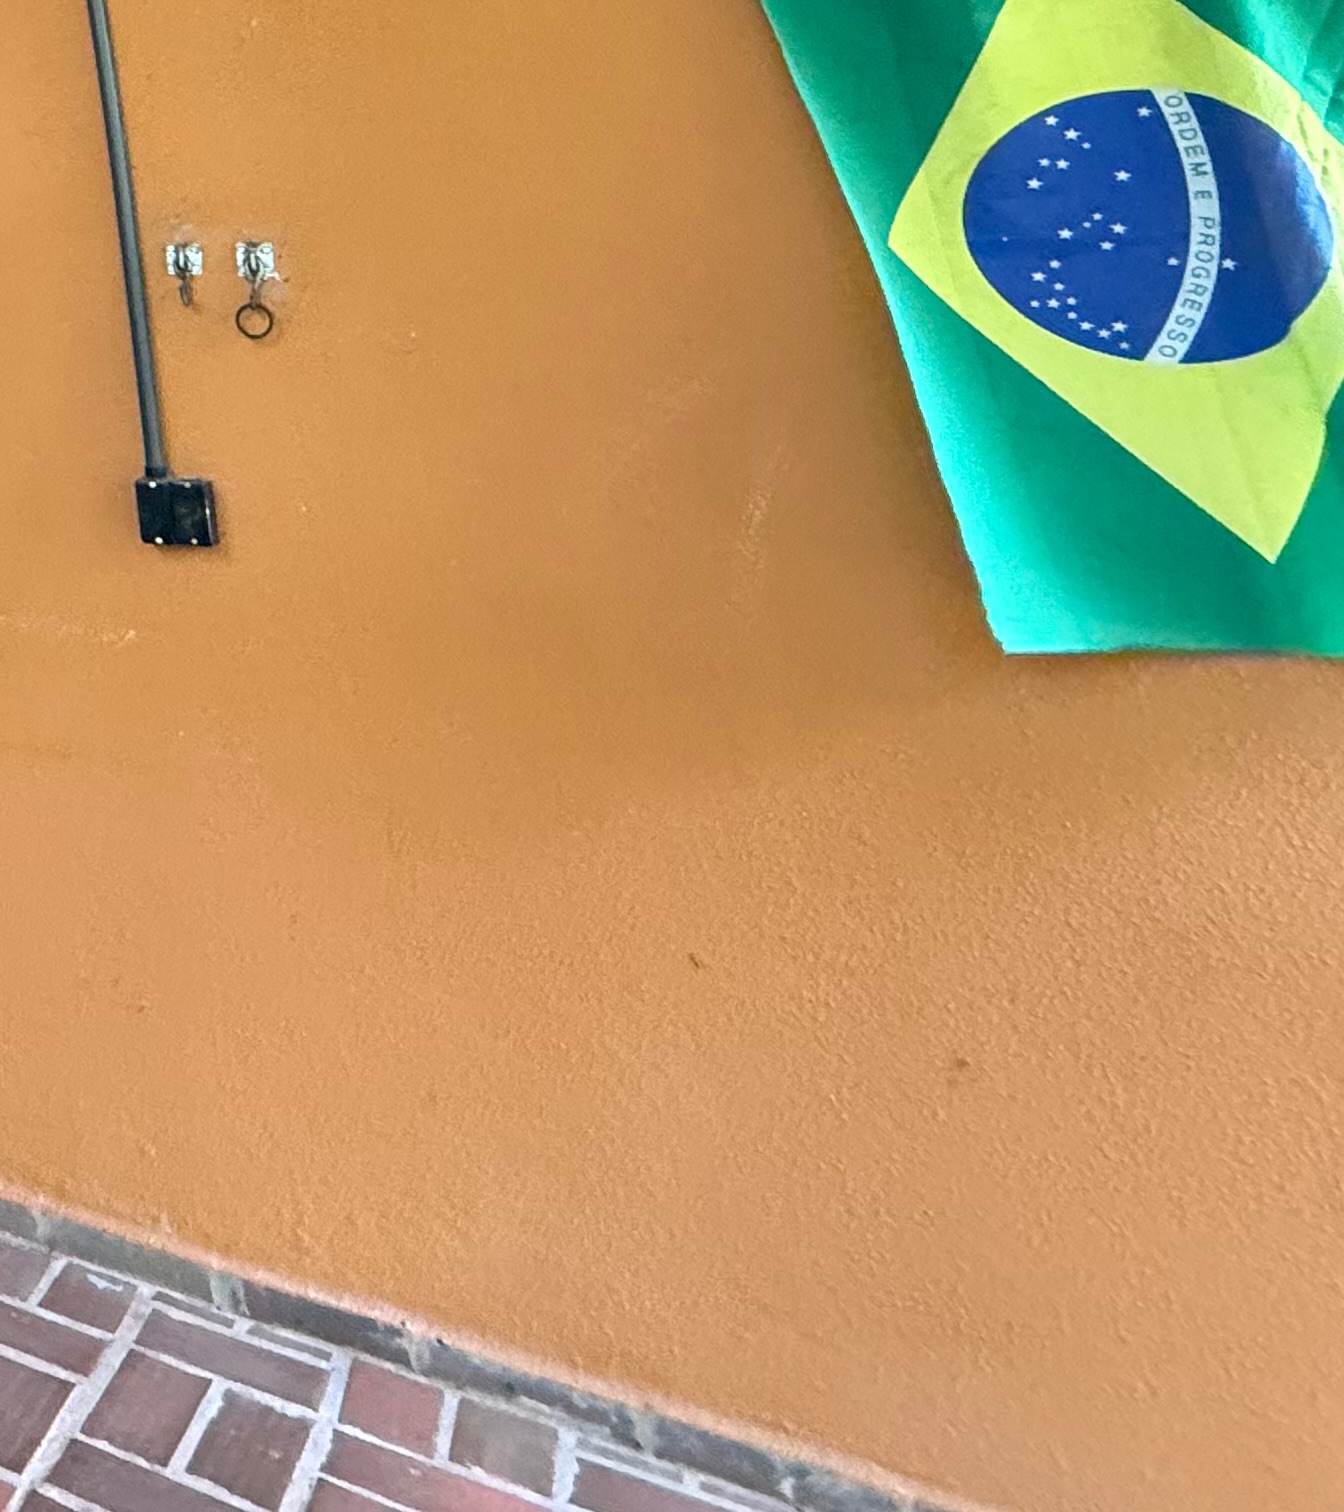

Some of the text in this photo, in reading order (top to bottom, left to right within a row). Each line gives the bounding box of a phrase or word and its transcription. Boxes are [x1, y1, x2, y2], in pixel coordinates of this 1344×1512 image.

[1157, 94, 1216, 359] ORDEM E PROGRESSO
